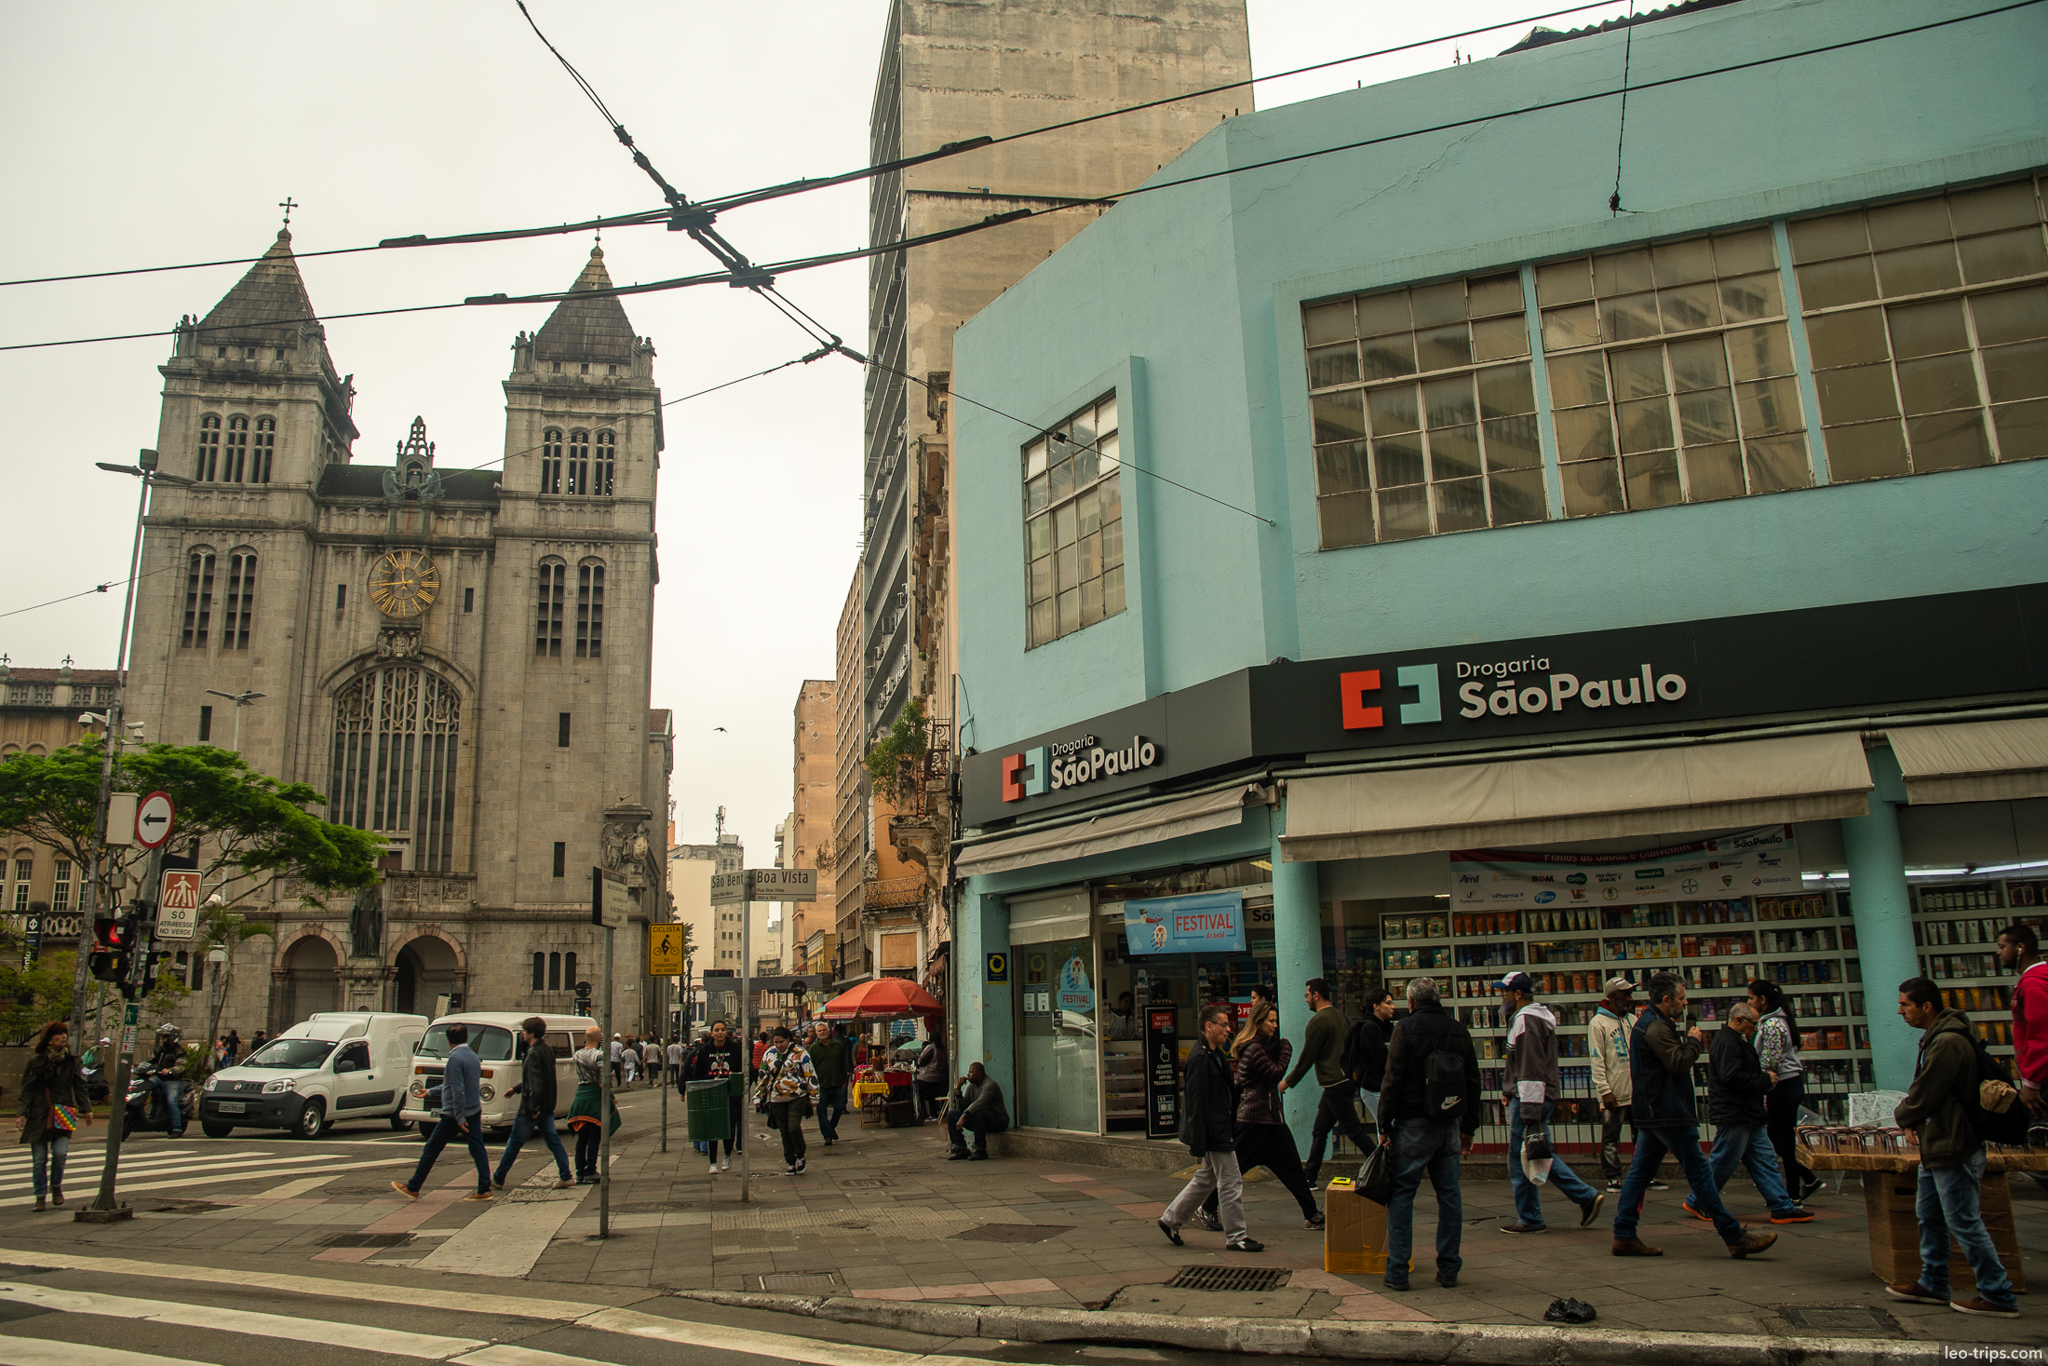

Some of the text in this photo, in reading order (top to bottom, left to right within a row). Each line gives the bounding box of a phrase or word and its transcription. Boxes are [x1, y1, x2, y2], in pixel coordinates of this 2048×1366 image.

[1456, 654, 1550, 678] Drogaria
[1459, 664, 1686, 718] SãoPaulo
[1052, 734, 1094, 757] Drogaria
[1051, 735, 1156, 790] SãoPaulo
[1734, 835, 1782, 848] SãoPaulo
[712, 873, 744, 889] São Bent
[757, 871, 809, 884] Boa Vista
[1460, 874, 1479, 883] Amil
[1536, 893, 1556, 904] Pfizer
[171, 909, 185, 920] SÓ
[1176, 913, 1234, 932] FESTIVAL
[1062, 995, 1089, 1004] FESTIVAL
